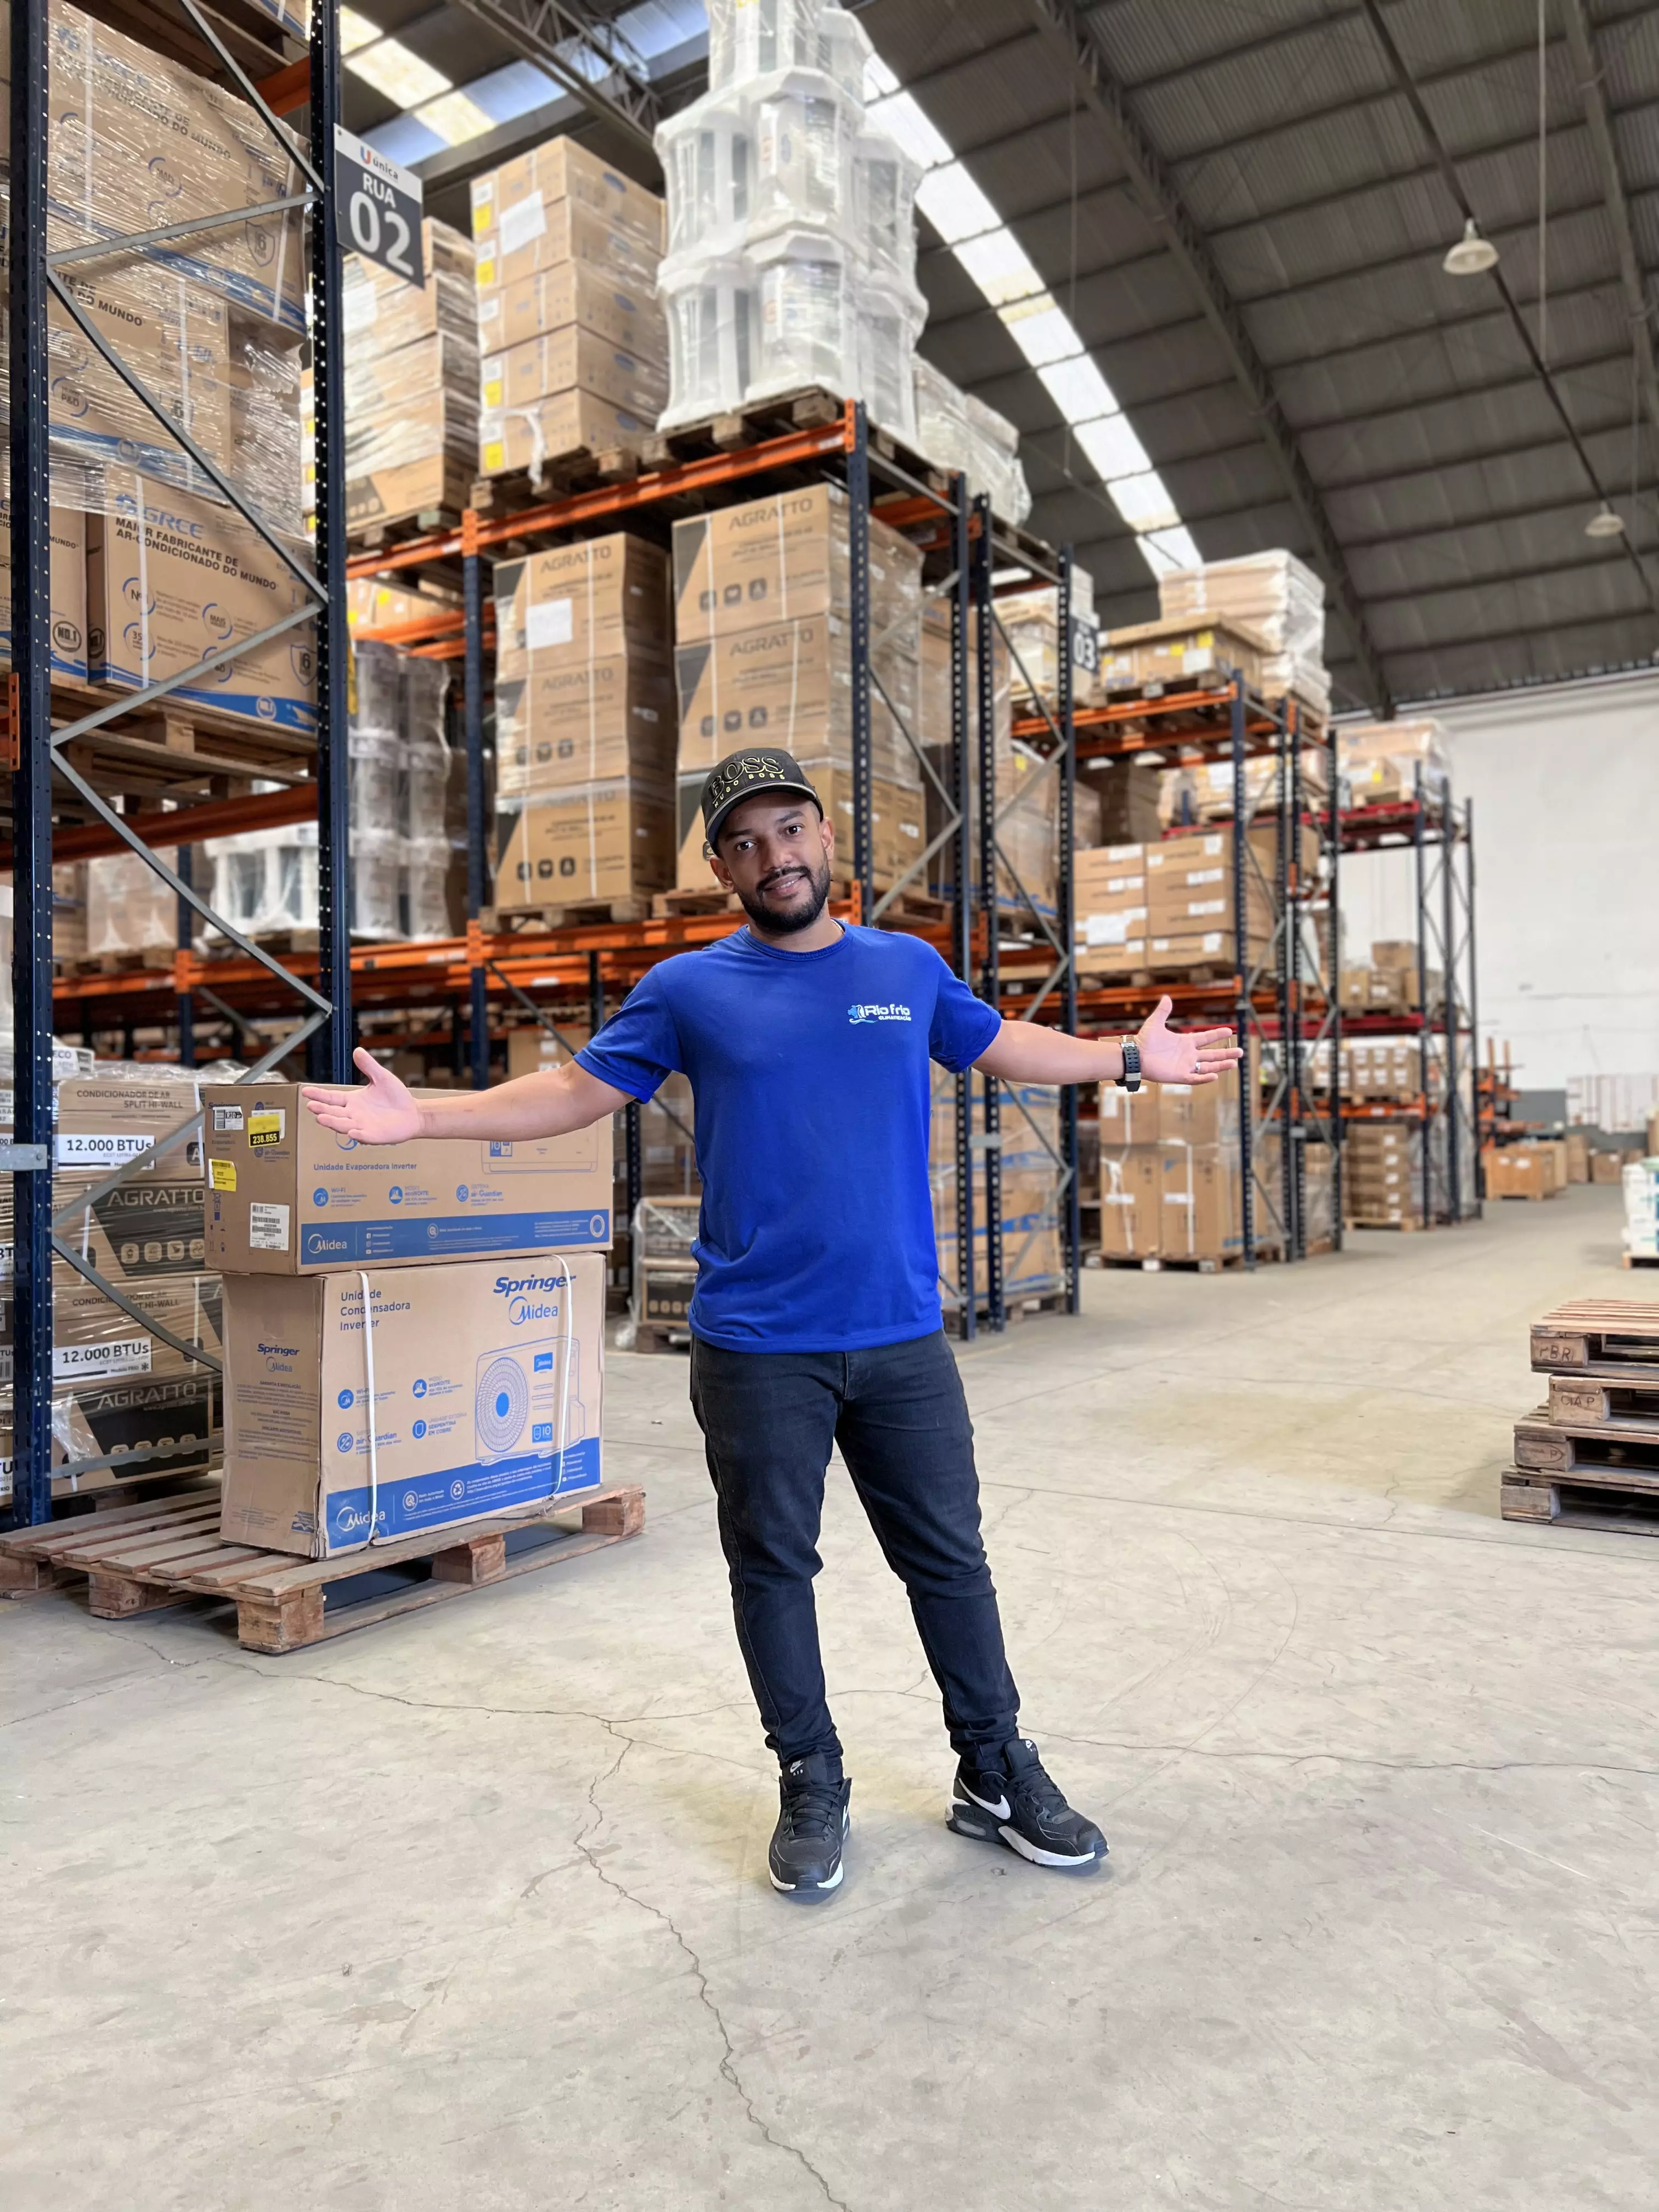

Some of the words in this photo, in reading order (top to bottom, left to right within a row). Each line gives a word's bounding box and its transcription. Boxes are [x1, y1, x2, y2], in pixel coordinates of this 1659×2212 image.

[172, 122, 189, 136] DO
[373, 157, 399, 180] única
[363, 172, 396, 209] RUA
[349, 191, 414, 275] 02
[257, 234, 267, 252] 6
[98, 300, 143, 327] MUNDO
[61, 392, 80, 408] P&D
[144, 505, 205, 540] GREE
[729, 498, 813, 531] AGRATTO
[49, 535, 77, 550] MUNDO
[116, 517, 153, 538] MAIR
[156, 532, 222, 561] FABRICANTE
[225, 555, 239, 567] DE
[223, 565, 238, 577] DO
[240, 571, 277, 591] MUNDO
[1073, 632, 1096, 669] 03
[302, 652, 311, 670] 6
[708, 755, 784, 804] BOSS
[714, 780, 740, 809] HUGO
[77, 1090, 147, 1098] CONDICIONADOR
[124, 1101, 145, 1109] SPLIT
[67, 1139, 114, 1152] 12.000
[117, 1139, 152, 1152] BTUs
[252, 1133, 278, 1144] 238.855
[346, 1163, 390, 1171] Evaporadora
[108, 1188, 205, 1207] AGRATTO
[311, 1235, 347, 1252] Midea
[493, 1274, 577, 1298] Springer
[145, 1299, 179, 1308] HI-WALL
[341, 1289, 382, 1302] Unidde
[340, 1301, 411, 1316] Condnsadora
[510, 1300, 558, 1323] Midea
[340, 1318, 380, 1331] Inverer
[63, 1347, 110, 1363] 12.000
[113, 1342, 150, 1358] BTUs
[257, 1343, 300, 1357] Springer
[268, 1359, 292, 1372] Midea
[97, 1383, 197, 1410] AGRATTO
